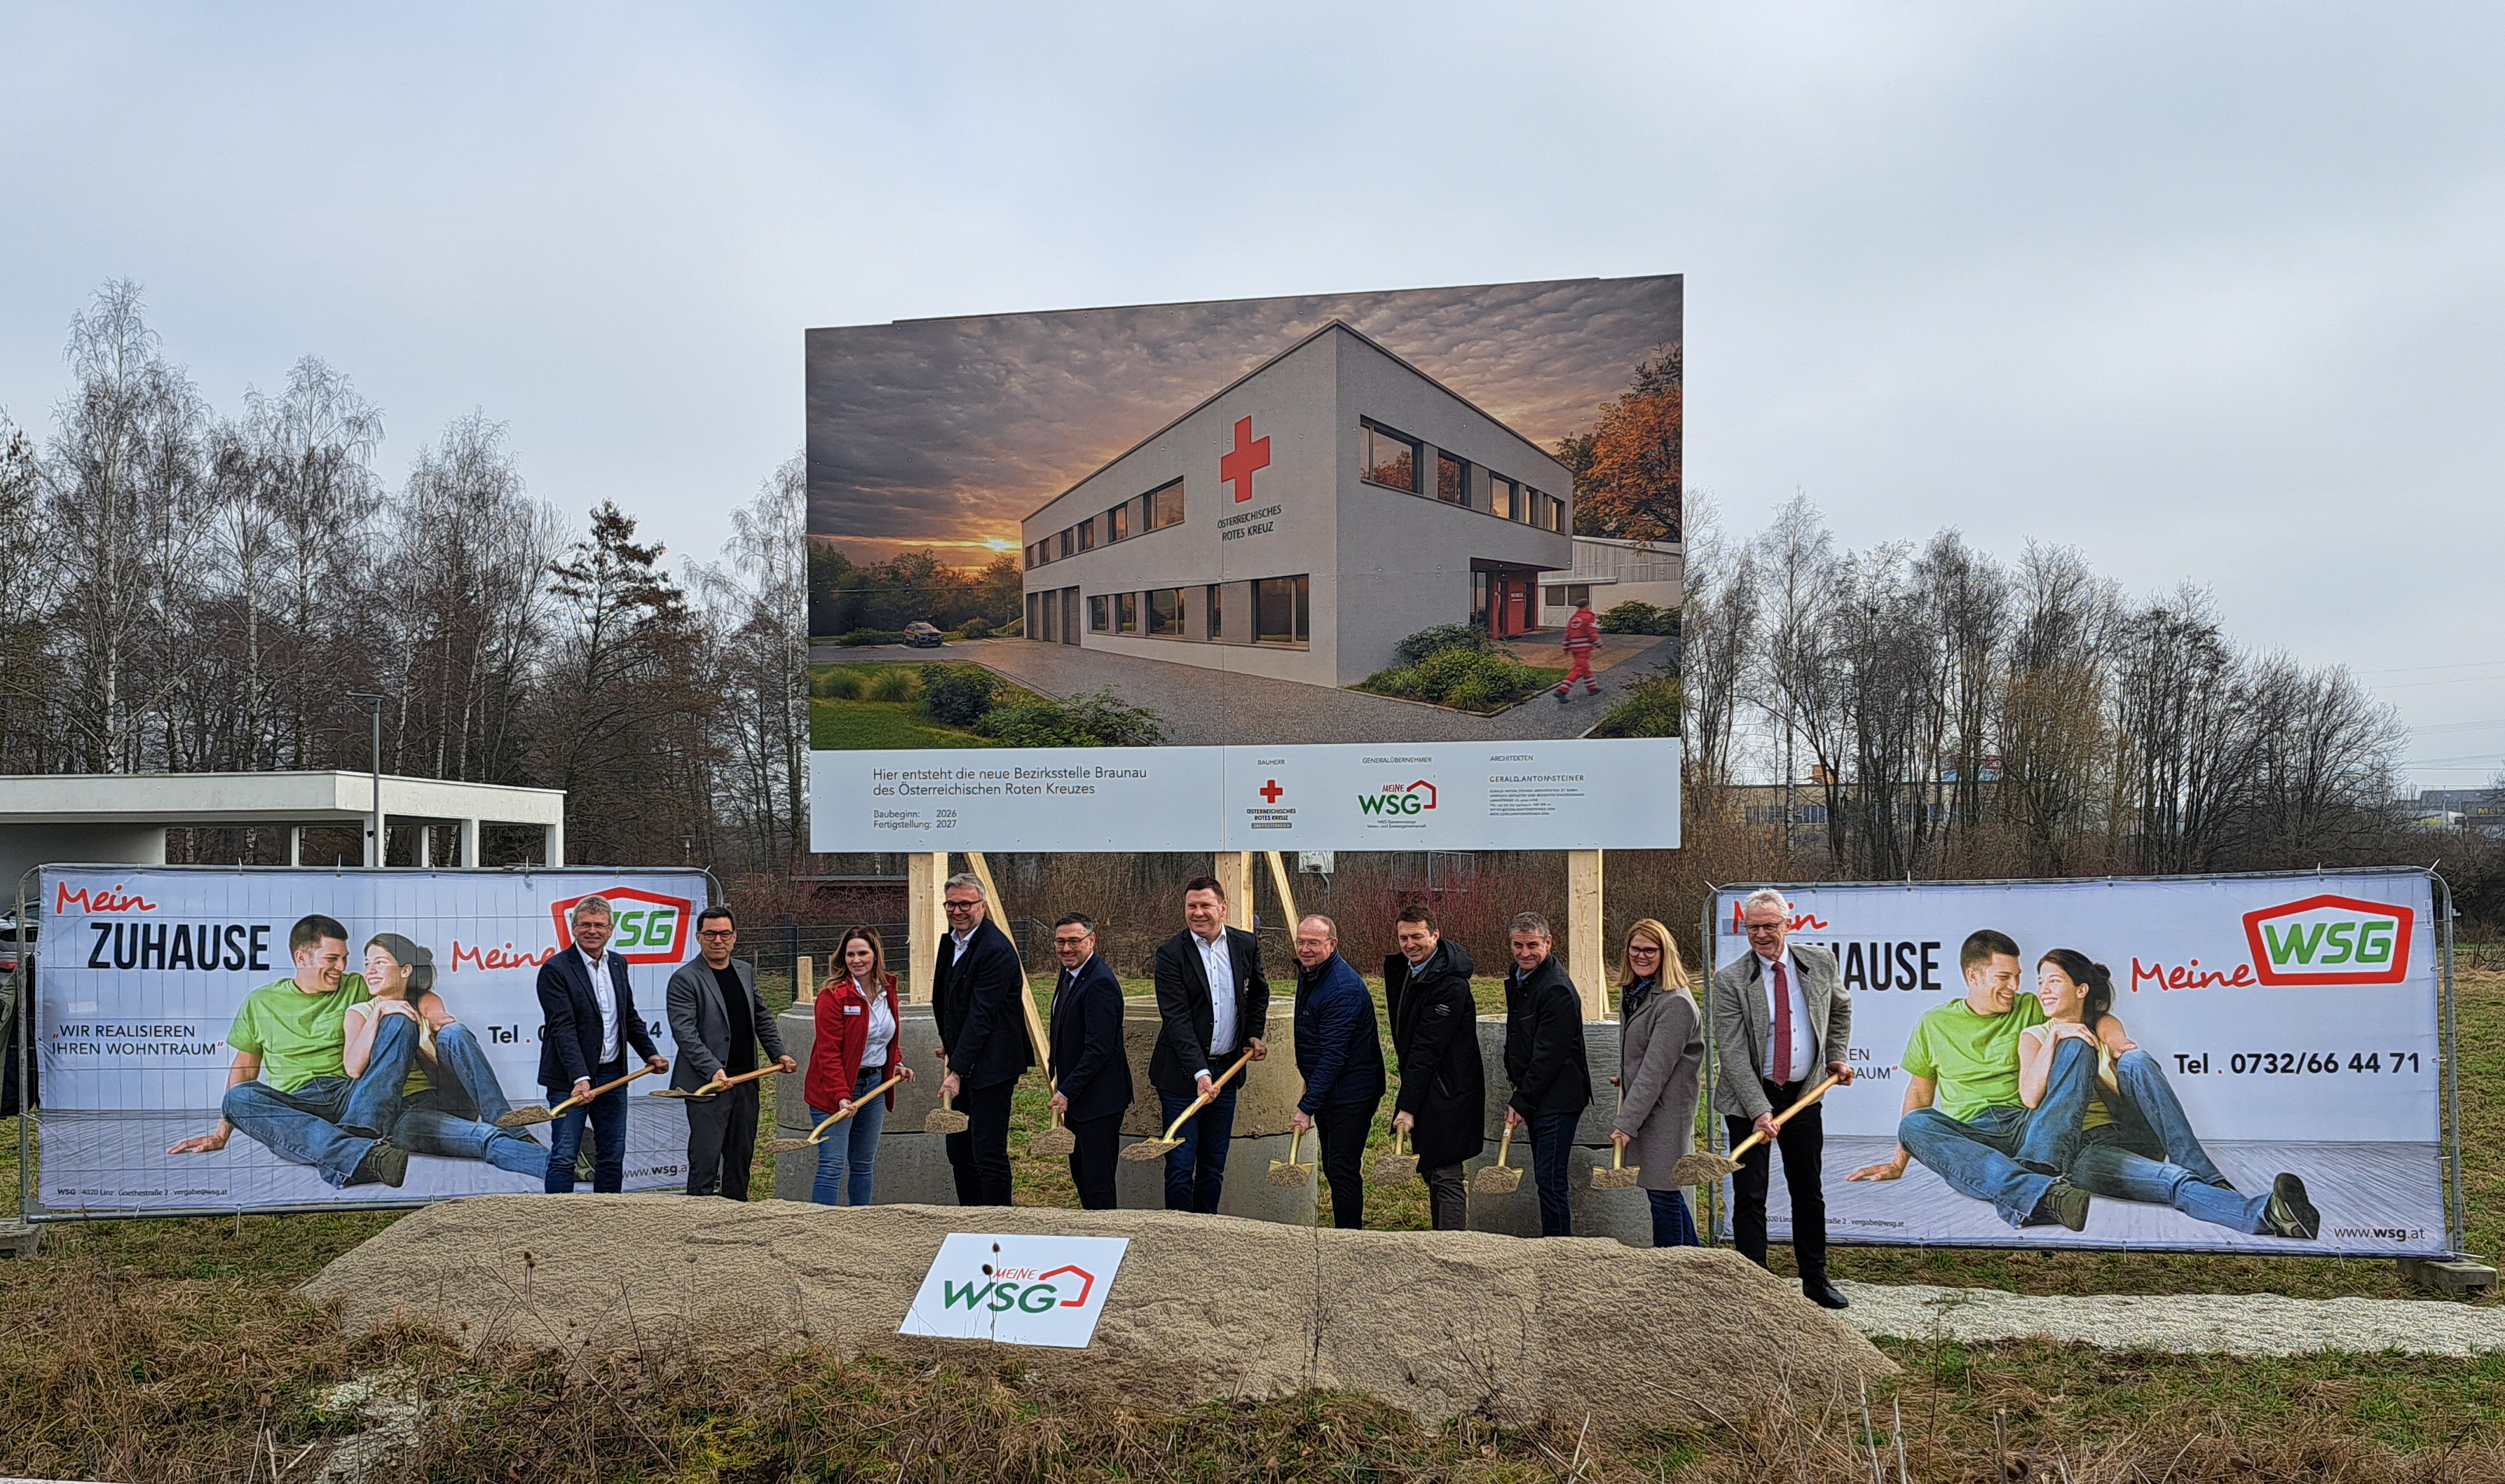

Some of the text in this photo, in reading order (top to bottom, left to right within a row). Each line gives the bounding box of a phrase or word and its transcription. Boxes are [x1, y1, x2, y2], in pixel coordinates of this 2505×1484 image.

[1222, 521, 1274, 542] ROTES KREUZ
[873, 766, 1147, 780] Hier entsteht die neue Bezirksstelle Braunau
[873, 781, 1095, 795] des Österreichischen Roten Kreuzes
[1382, 783, 1405, 793] MEINE
[1358, 794, 1421, 815] WSG
[873, 809, 957, 820] Baubeginn: 2026
[873, 819, 957, 830] Fertigstellung: 2027
[57, 881, 156, 914] Mein
[88, 922, 271, 970] ZUHAUSE
[452, 940, 556, 973] Meine
[2131, 921, 2394, 992] Meine WSG
[1831, 941, 1941, 991] AUSE
[95, 1025, 195, 1038] REALISIEREN
[53, 1043, 100, 1054] IHREN
[2231, 1052, 2339, 1074] 0732/66
[2348, 1053, 2380, 1073] 44
[2389, 1053, 2419, 1073] 71
[2334, 1228, 2426, 1242] www.wsg.at
[992, 1268, 1038, 1280] MEINE
[945, 1281, 1058, 1314] WSG
